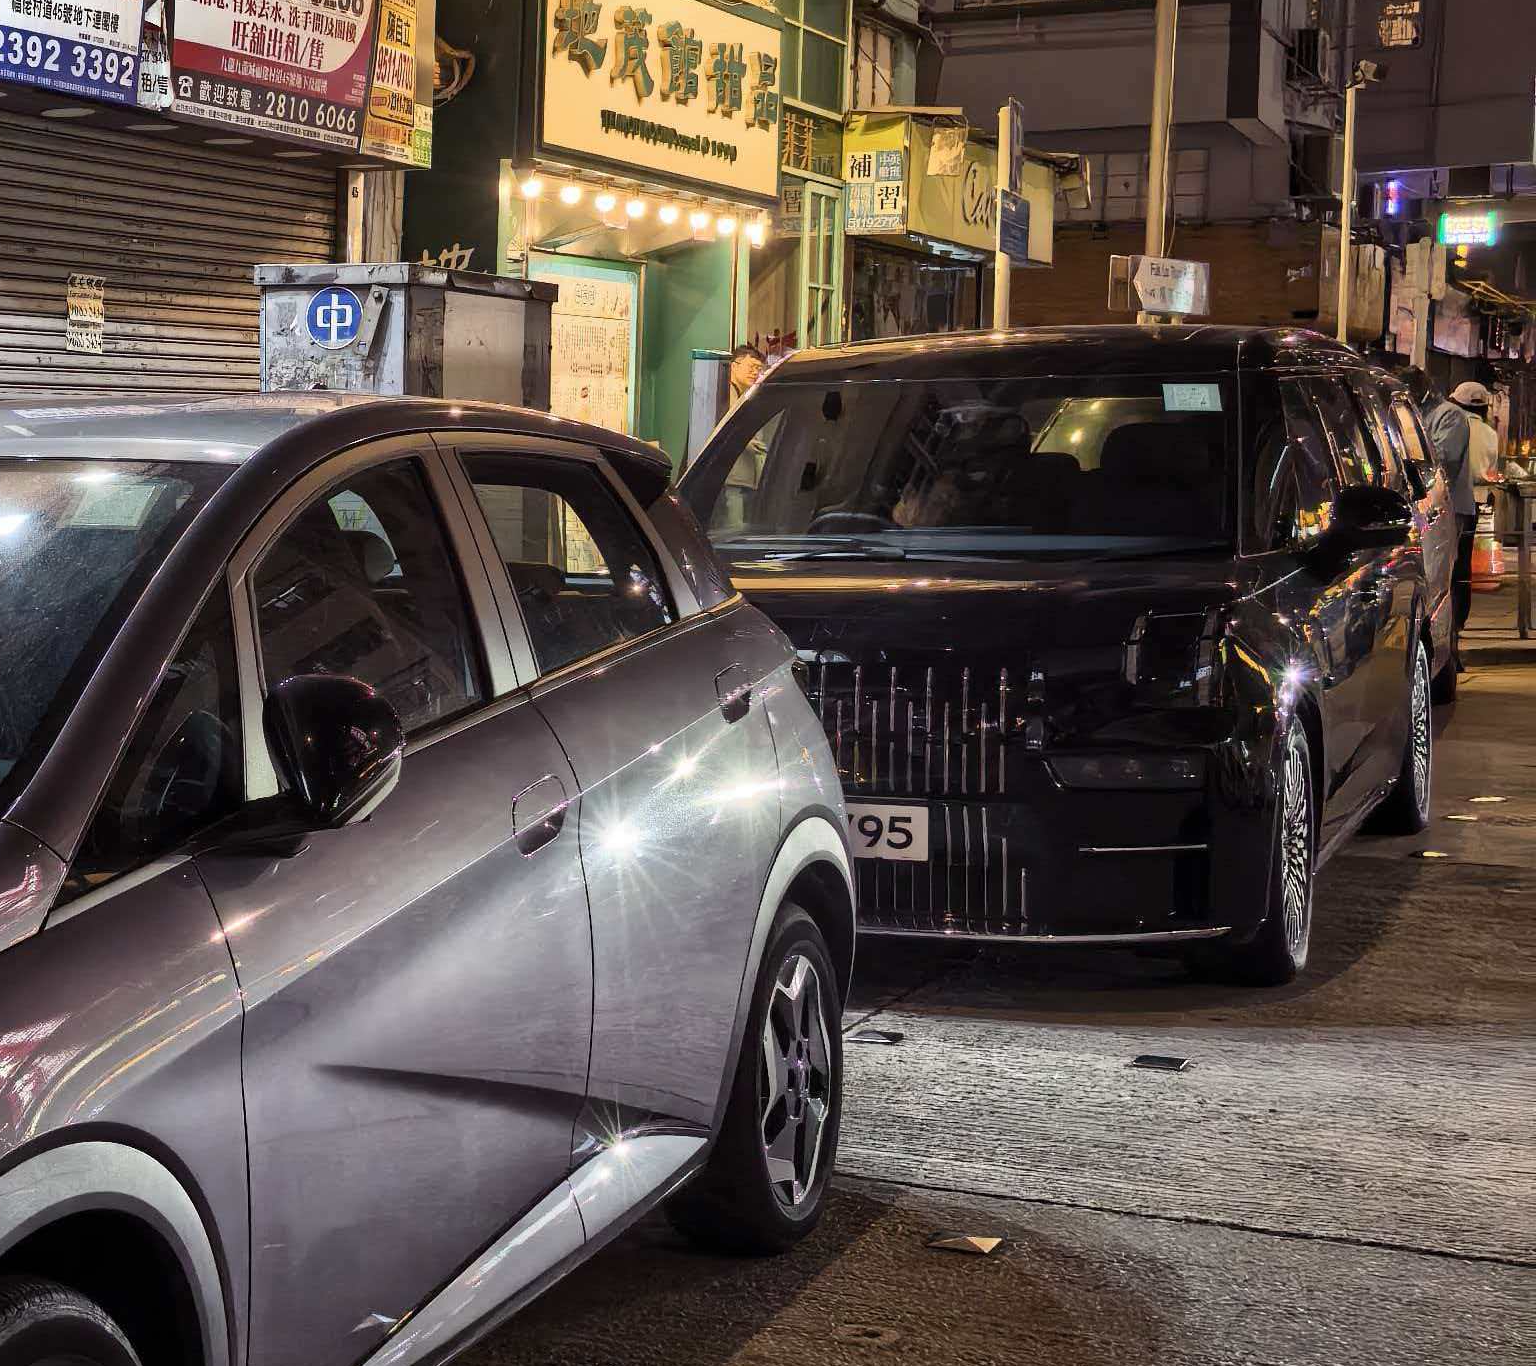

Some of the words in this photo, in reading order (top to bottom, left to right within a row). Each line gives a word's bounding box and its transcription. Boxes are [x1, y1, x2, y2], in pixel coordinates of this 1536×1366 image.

[71, 45, 135, 87] 3392
[265, 91, 310, 122] 2810
[315, 103, 356, 133] 6066
[850, 154, 872, 178] 補
[877, 185, 900, 210] 習
